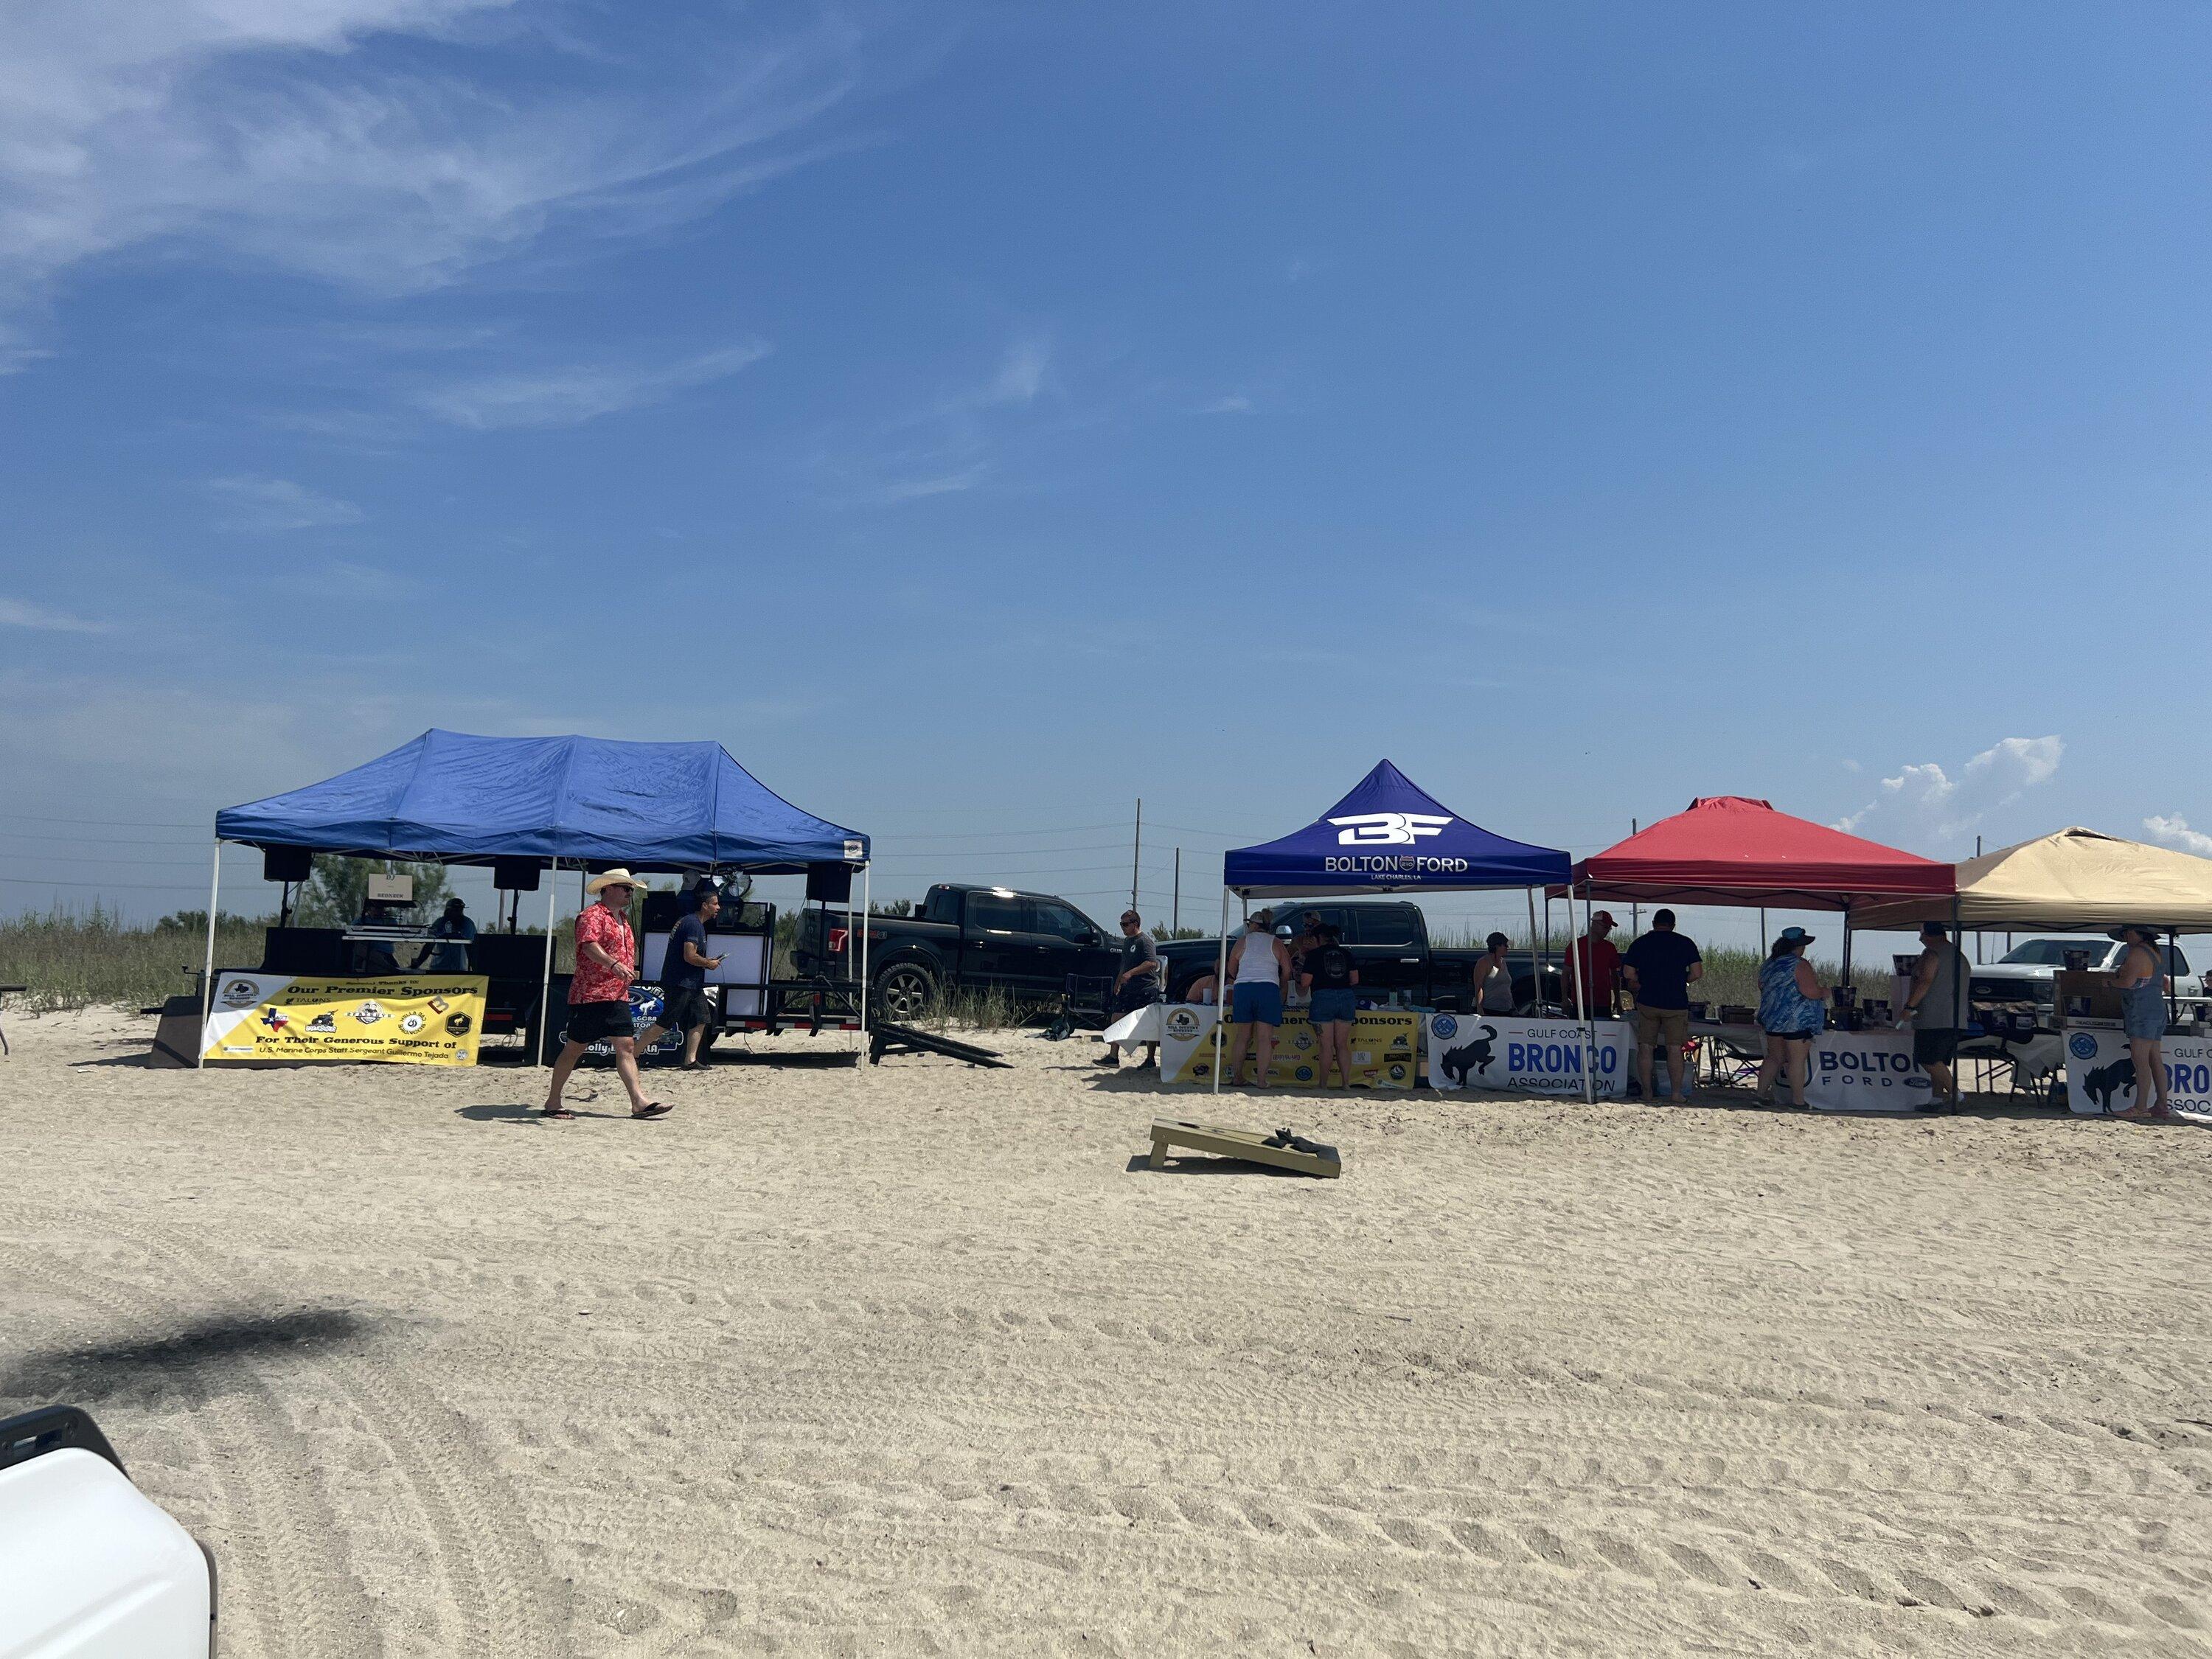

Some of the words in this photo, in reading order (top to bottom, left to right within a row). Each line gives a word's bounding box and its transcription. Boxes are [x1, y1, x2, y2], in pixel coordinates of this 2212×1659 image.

[1326, 813, 1454, 845] BF
[1324, 855, 1398, 872] BOLTON
[1416, 856, 1469, 873] FORD
[287, 986, 319, 994] Our
[324, 986, 395, 995] Premier
[400, 986, 478, 997] Sponsors
[1352, 1017, 1413, 1026] ponsors
[1527, 1029, 1558, 1038] GULF
[285, 1035, 319, 1043] Their
[324, 1036, 385, 1045] Generous
[389, 1037, 440, 1048] Support
[443, 1041, 457, 1049] of
[587, 1042, 608, 1052] olly
[647, 1044, 658, 1053] LA
[304, 1047, 327, 1055] Corps
[349, 1047, 385, 1056] Sergeant
[386, 1048, 422, 1057] Guillermo
[424, 1051, 449, 1060] Tejada
[1508, 1043, 1617, 1074] BRONCO
[2174, 1048, 2203, 1058] GULF
[1819, 1051, 1919, 1073] BOLTO
[1822, 1074, 1893, 1087] FORD
